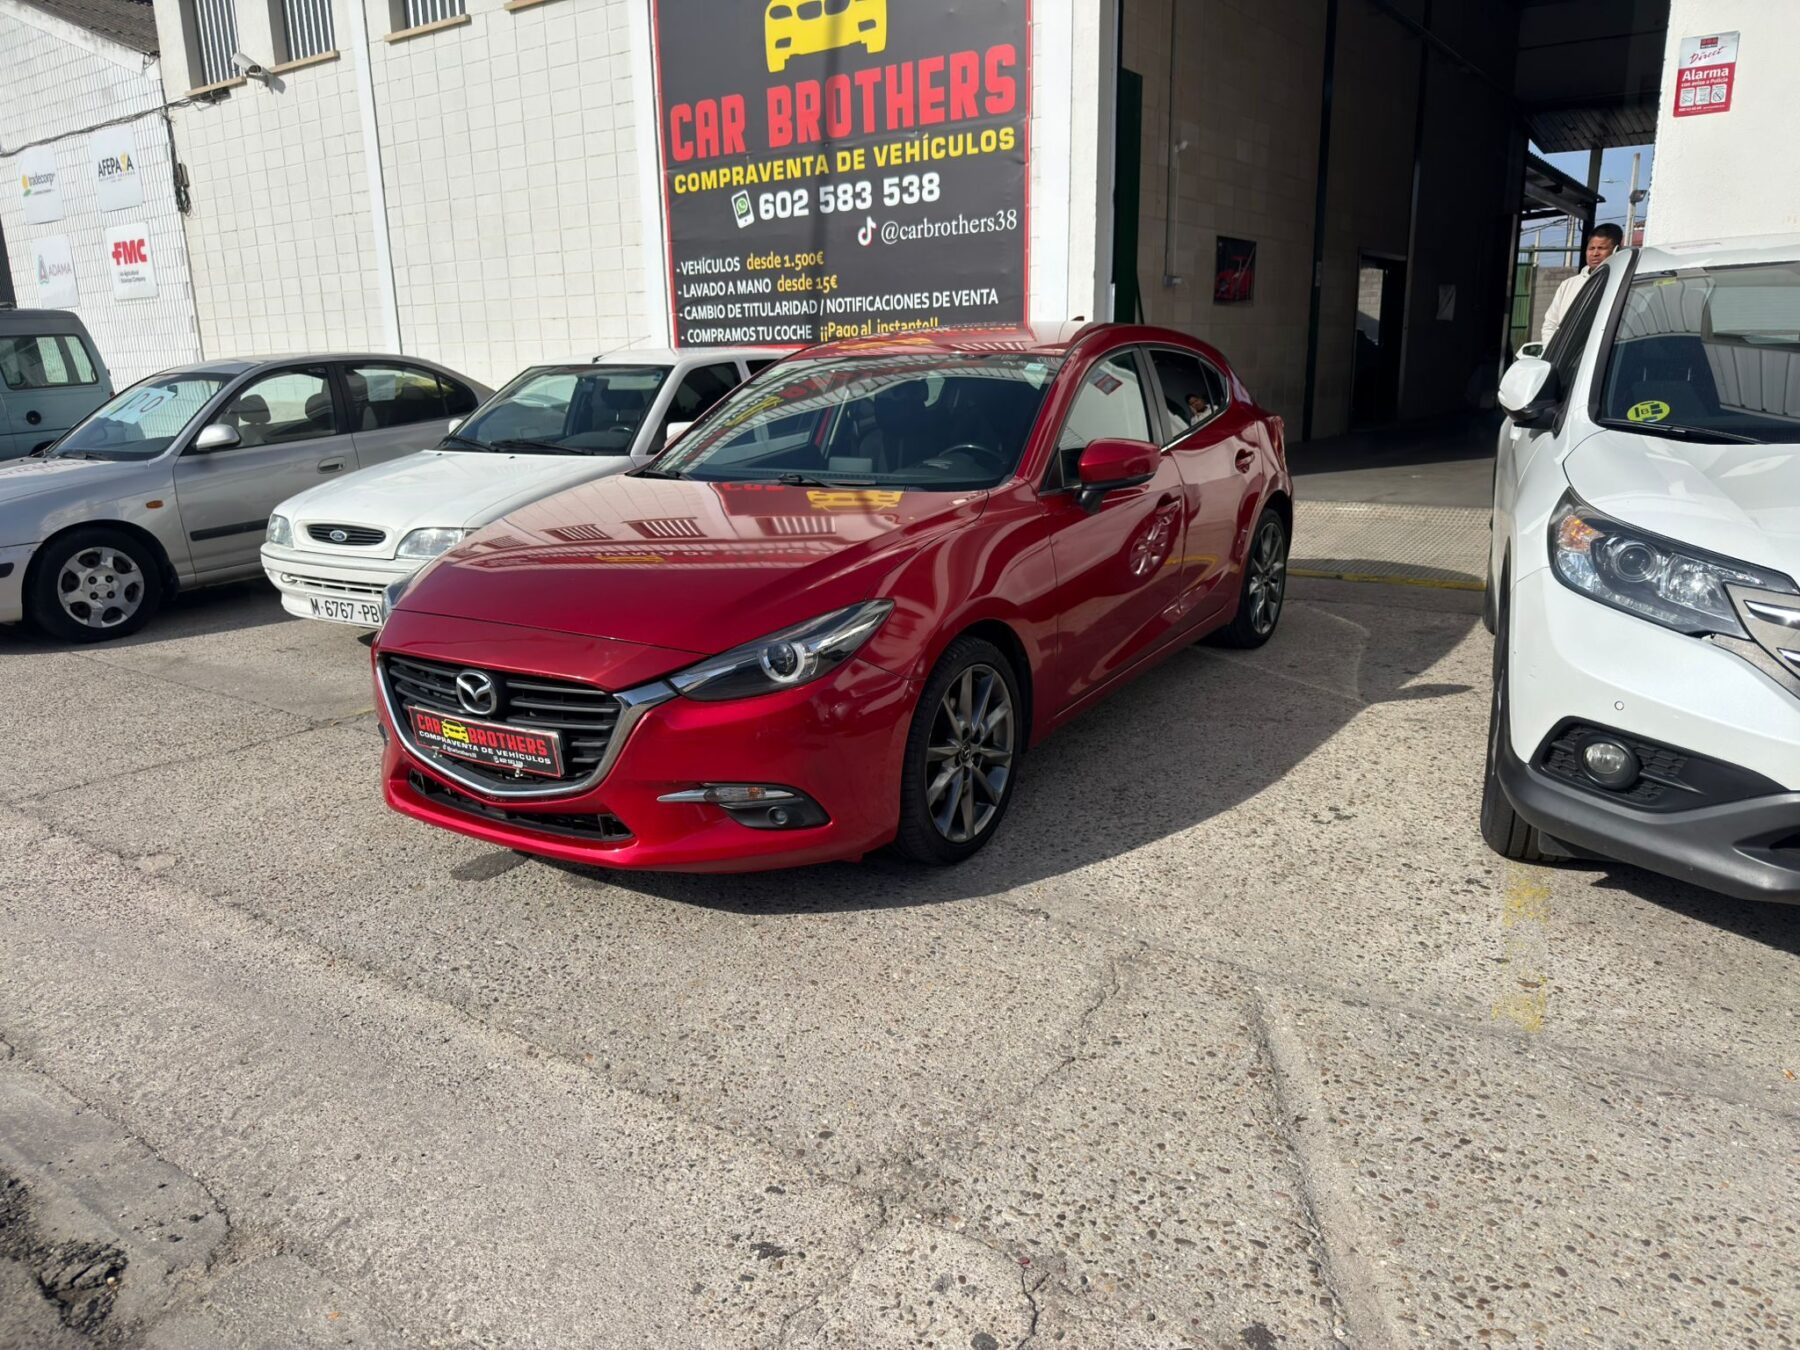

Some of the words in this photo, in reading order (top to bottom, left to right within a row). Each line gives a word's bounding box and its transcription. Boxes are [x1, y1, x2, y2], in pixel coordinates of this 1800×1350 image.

[1682, 68, 1729, 81] Alarma
[670, 94, 746, 162] CAR
[767, 43, 1016, 148] BROTHERS
[98, 154, 134, 177] AFEPAA
[674, 154, 829, 194] COMPRAVENTA
[836, 149, 866, 173] DE
[873, 127, 1015, 167] VEHÍCULOS
[759, 188, 810, 220] 602
[818, 180, 873, 214] 583
[882, 172, 941, 207] 538
[881, 209, 1018, 245] @carbrothers38
[112, 239, 147, 266] FMC
[681, 257, 740, 275] VEHÍCULOS
[746, 251, 781, 270] desde
[784, 252, 824, 271] 1.500€
[683, 281, 725, 298] LAVADO
[727, 281, 735, 295] A
[737, 278, 771, 294] MANO
[777, 273, 812, 292] desde
[816, 275, 838, 294] 15€
[684, 305, 725, 320] CAMBIO
[728, 303, 742, 318] DE
[743, 301, 818, 317] TITULARIDAD
[826, 292, 929, 314] NOTIFICACIONES
[932, 291, 950, 307] DE
[952, 288, 999, 307] VENTA
[687, 326, 756, 343] COMPRAMOS
[757, 325, 772, 341] TU
[774, 325, 812, 340] COCHE
[820, 321, 859, 342] ¡¡Pago
[860, 319, 872, 336] al
[416, 714, 441, 734] CAR
[468, 727, 548, 756] BROTHERS
[419, 730, 479, 752] COMPRAVENTA
[481, 746, 494, 755] DE
[496, 749, 551, 764] VEHÍCULOS
